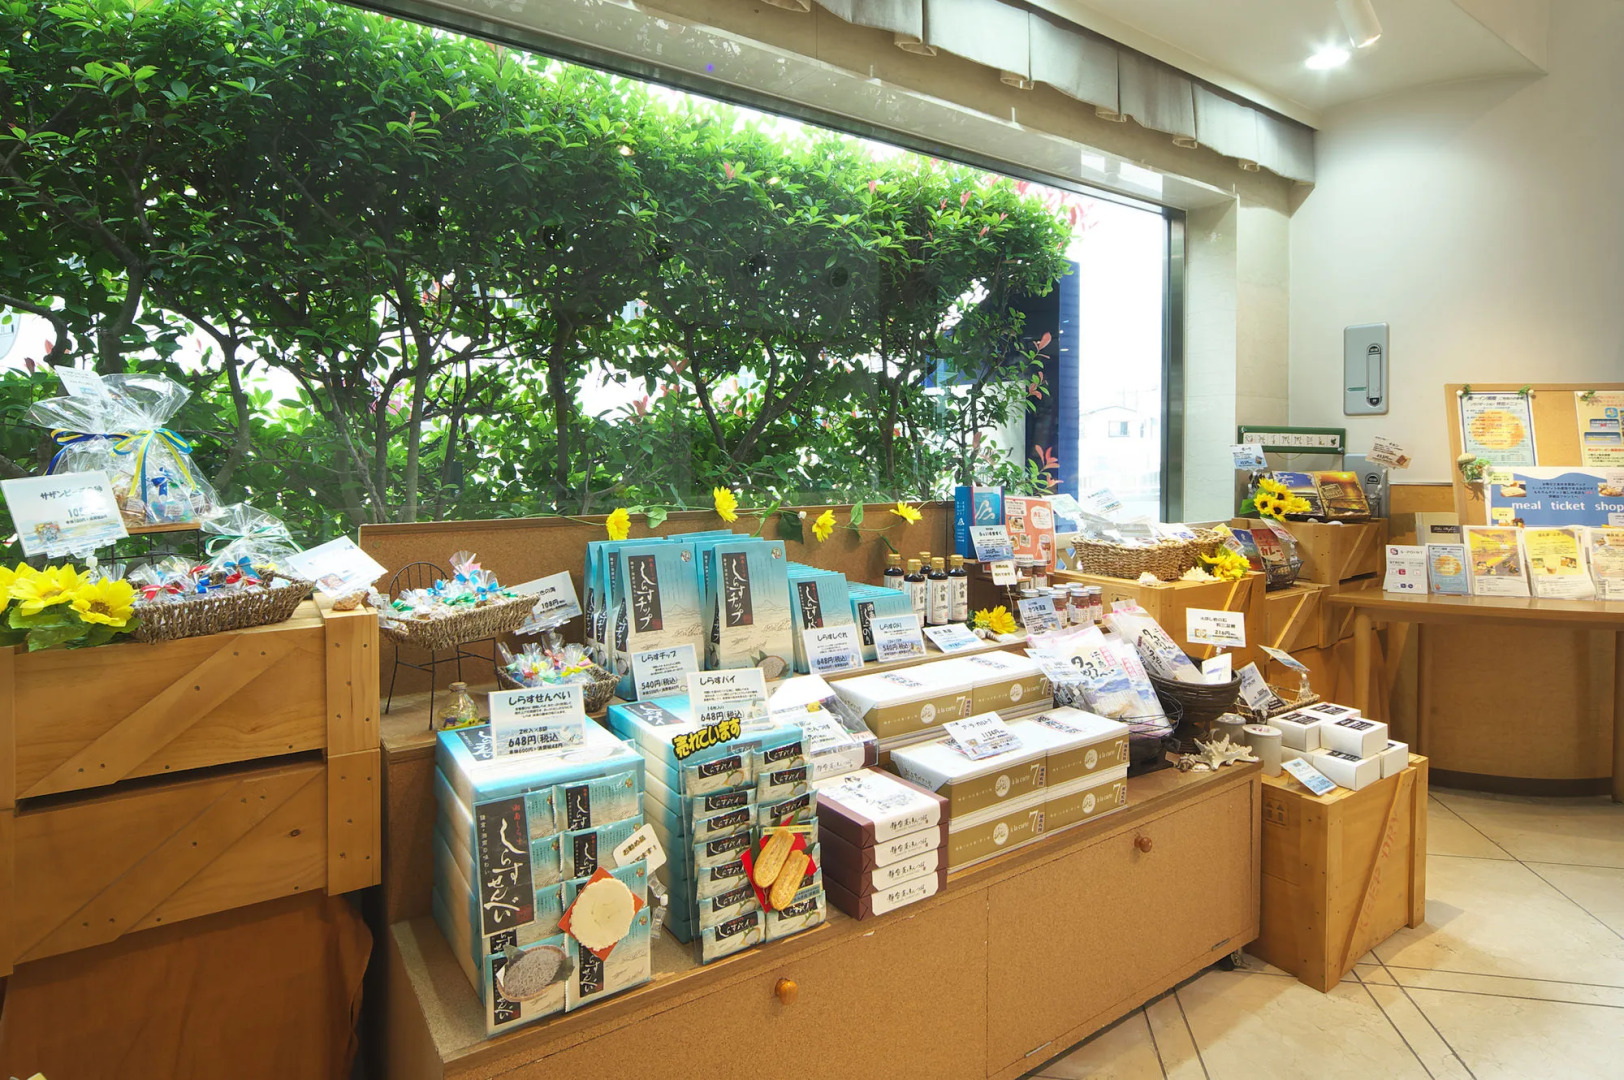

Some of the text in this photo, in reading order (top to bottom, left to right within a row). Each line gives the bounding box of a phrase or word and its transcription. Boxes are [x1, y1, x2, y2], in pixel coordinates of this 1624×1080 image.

[1512, 500, 1624, 513] meal ticket shop
[635, 560, 657, 630] しらすチップ
[727, 558, 748, 625] しらすチップ
[817, 632, 848, 642] しらすしぐれ
[641, 650, 677, 663] しらすチップ
[641, 675, 679, 690] 540円(税込)
[699, 675, 736, 686] しらすパイ
[508, 690, 571, 706] しらすせんべい
[956, 695, 966, 716] 7
[673, 717, 741, 758] 売れています
[1114, 740, 1124, 760] 7
[1030, 763, 1040, 786] 7
[1113, 783, 1122, 804] 7
[1029, 810, 1039, 832] 7
[484, 817, 528, 923] しらすせんべい
